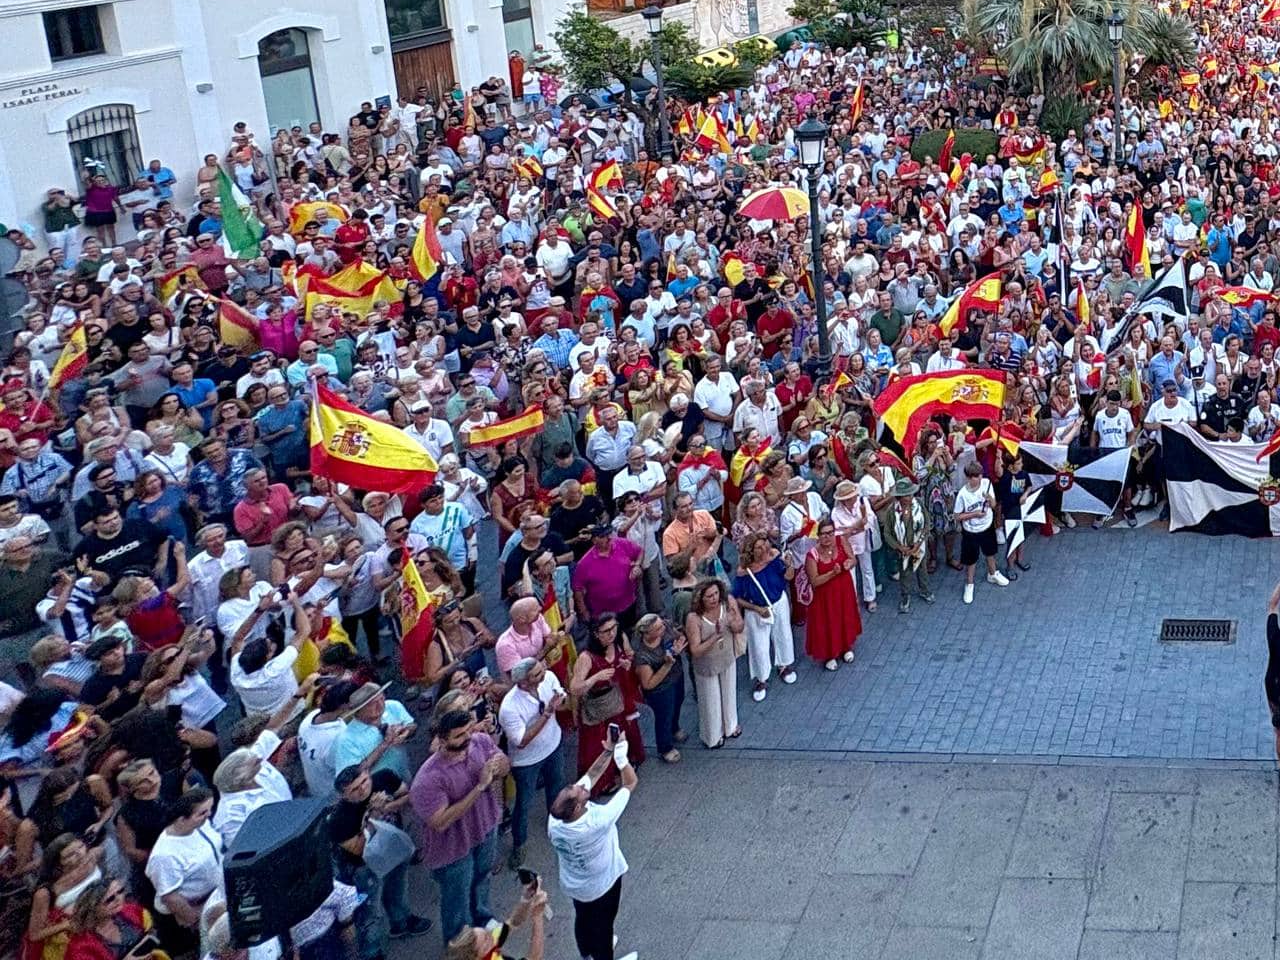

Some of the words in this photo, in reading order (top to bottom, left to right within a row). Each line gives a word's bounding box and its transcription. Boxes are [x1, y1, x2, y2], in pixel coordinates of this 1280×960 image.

[2, 95, 41, 109] ISAAC
[44, 87, 82, 101] PERAL
[21, 83, 59, 97] PLAZA
[95, 540, 140, 564] adidas
